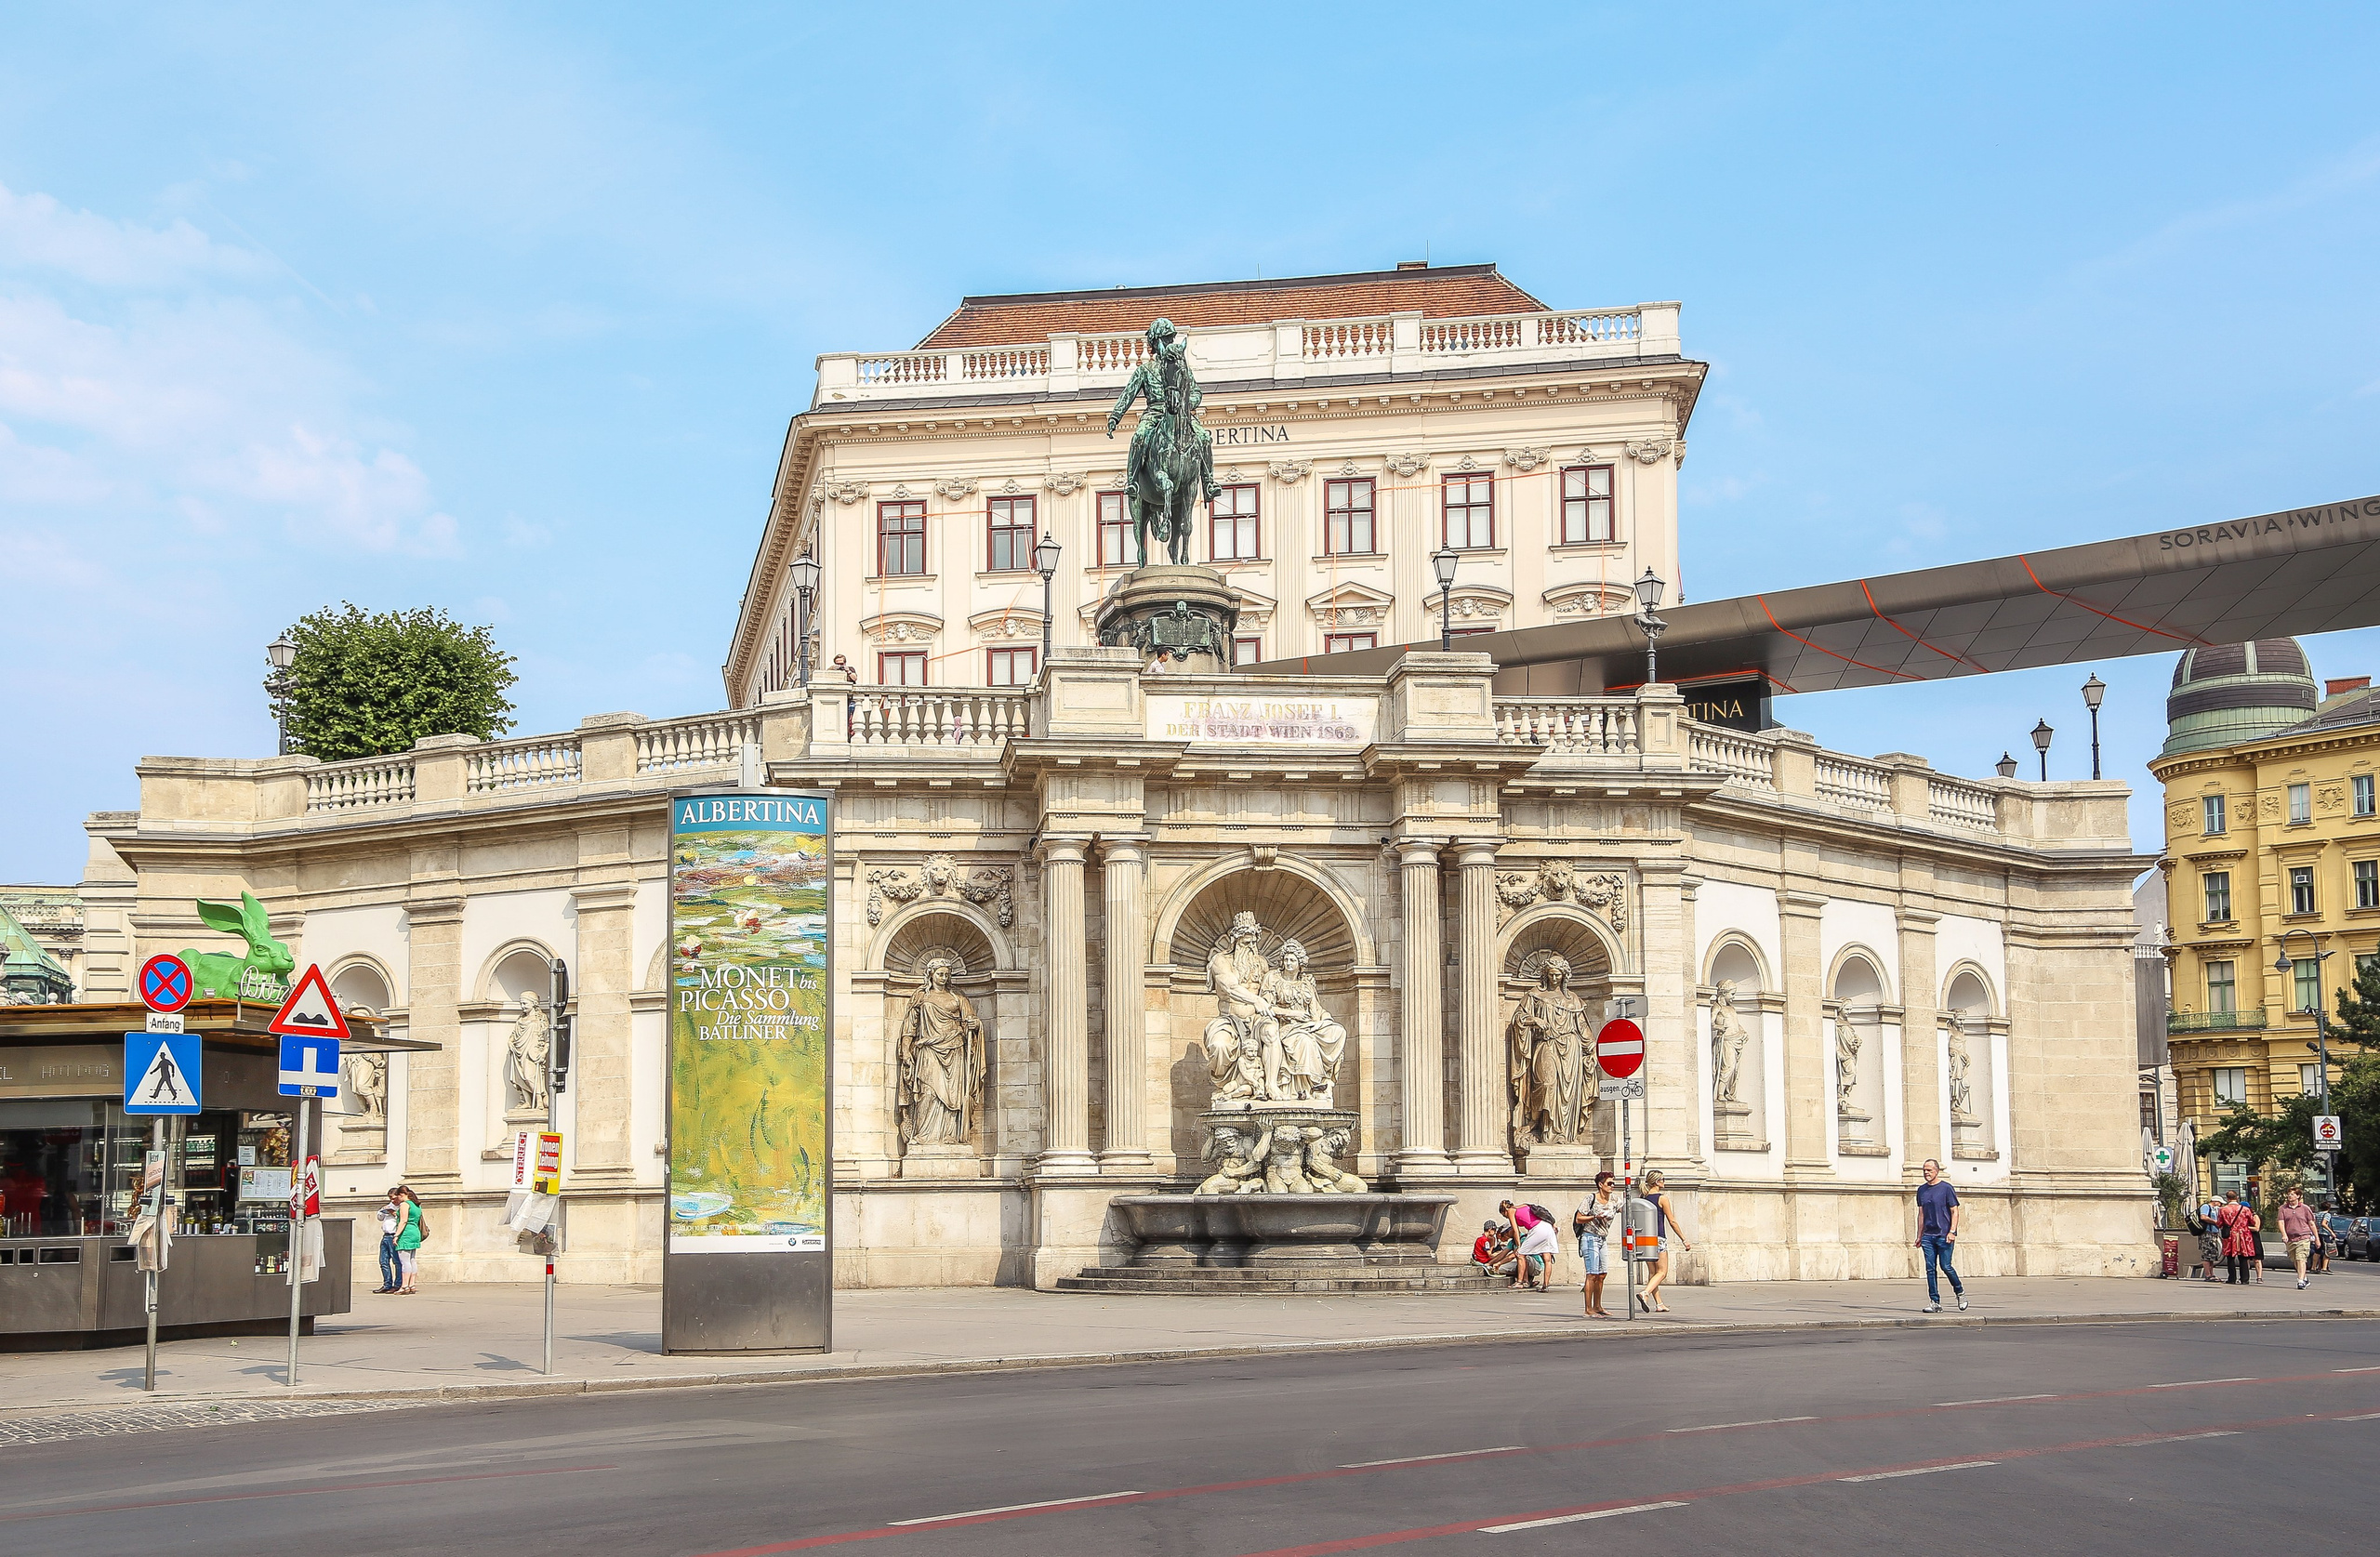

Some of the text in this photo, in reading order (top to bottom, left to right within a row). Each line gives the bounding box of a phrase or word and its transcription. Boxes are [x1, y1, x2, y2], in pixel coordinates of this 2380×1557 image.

[2160, 500, 2380, 550] SORAVIA WING
[1183, 702, 1251, 719] FRANZ
[1260, 703, 1323, 720] JOSEF
[1165, 723, 1200, 736] DER
[1207, 724, 1262, 738] STADT
[1269, 724, 1312, 739] WIEN
[680, 799, 821, 825] ALBERTINA
[699, 967, 818, 990] MONET bis
[680, 988, 790, 1012] PICASSO
[151, 1017, 181, 1032] Anfang
[715, 1009, 820, 1031] Die Sammlung
[699, 1024, 787, 1041] BATLINER
[516, 1132, 527, 1183] ÖSTERREICH
